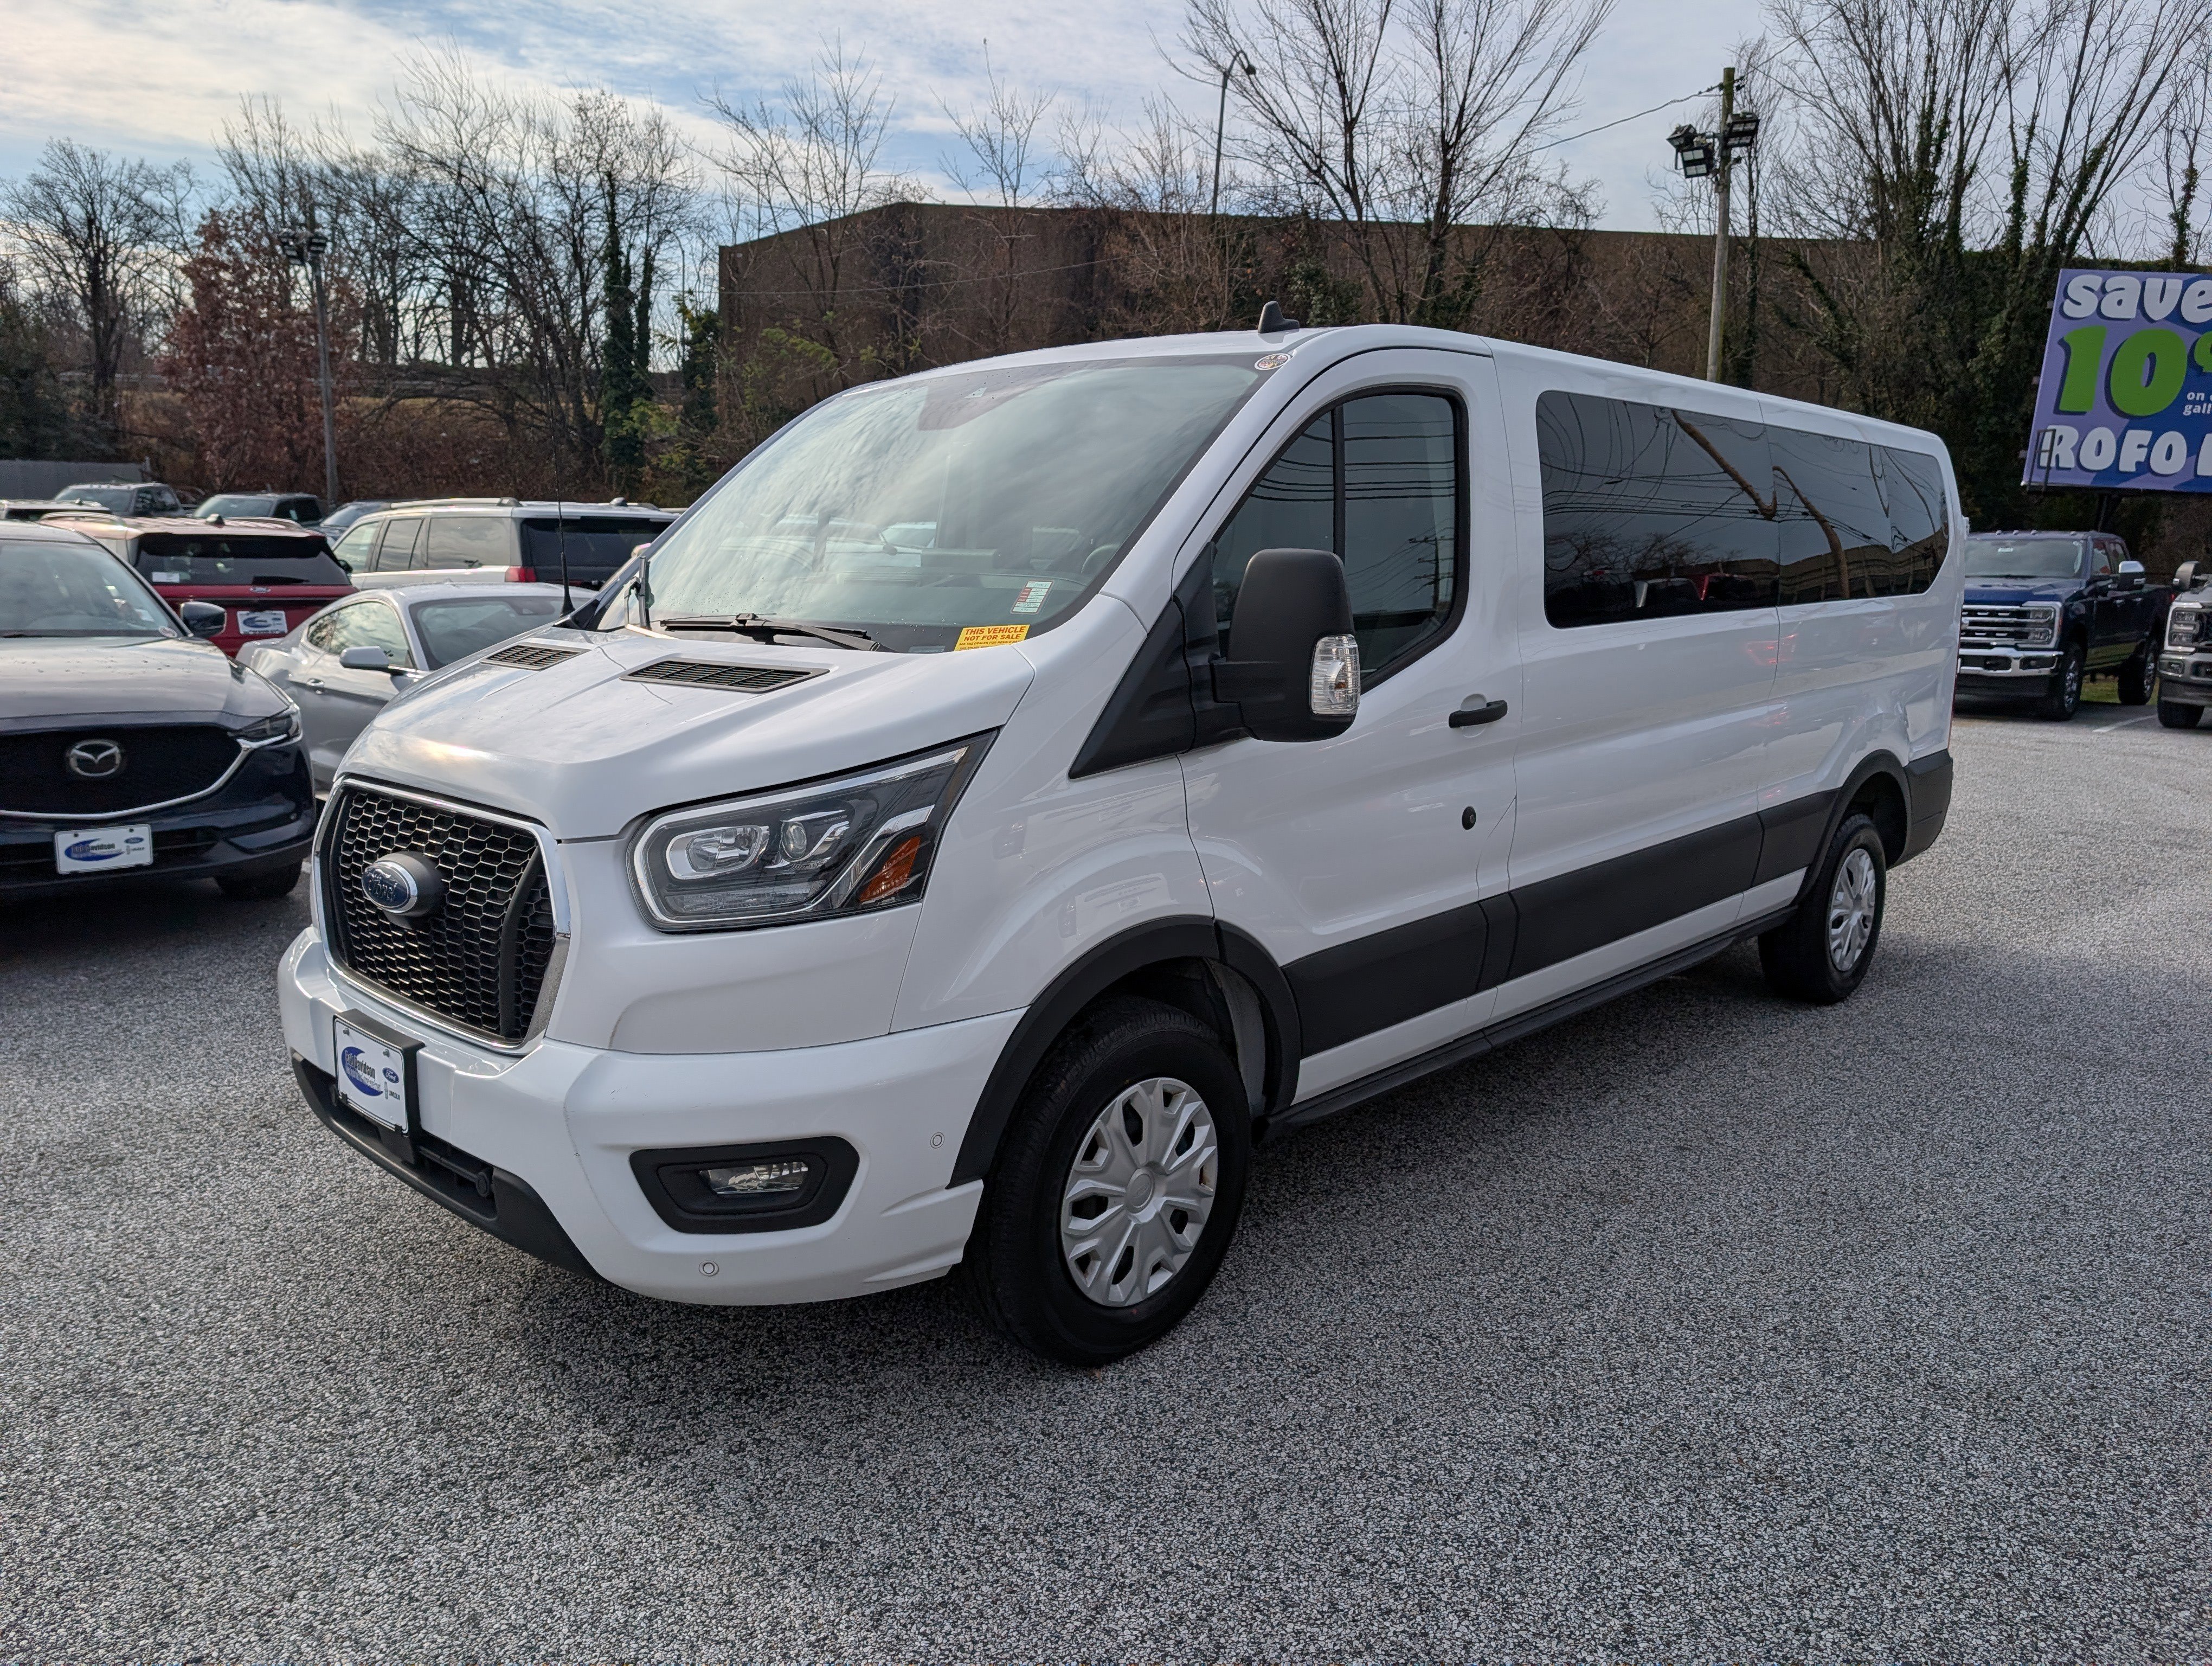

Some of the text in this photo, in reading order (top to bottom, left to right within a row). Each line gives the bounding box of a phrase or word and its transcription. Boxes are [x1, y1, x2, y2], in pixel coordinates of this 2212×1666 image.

[2187, 392, 2205, 401] on
[2183, 403, 2212, 416] gall
[2040, 425, 2188, 475] ROFO
[354, 1055, 375, 1079] Davidson
[385, 1069, 396, 1081] Ford
